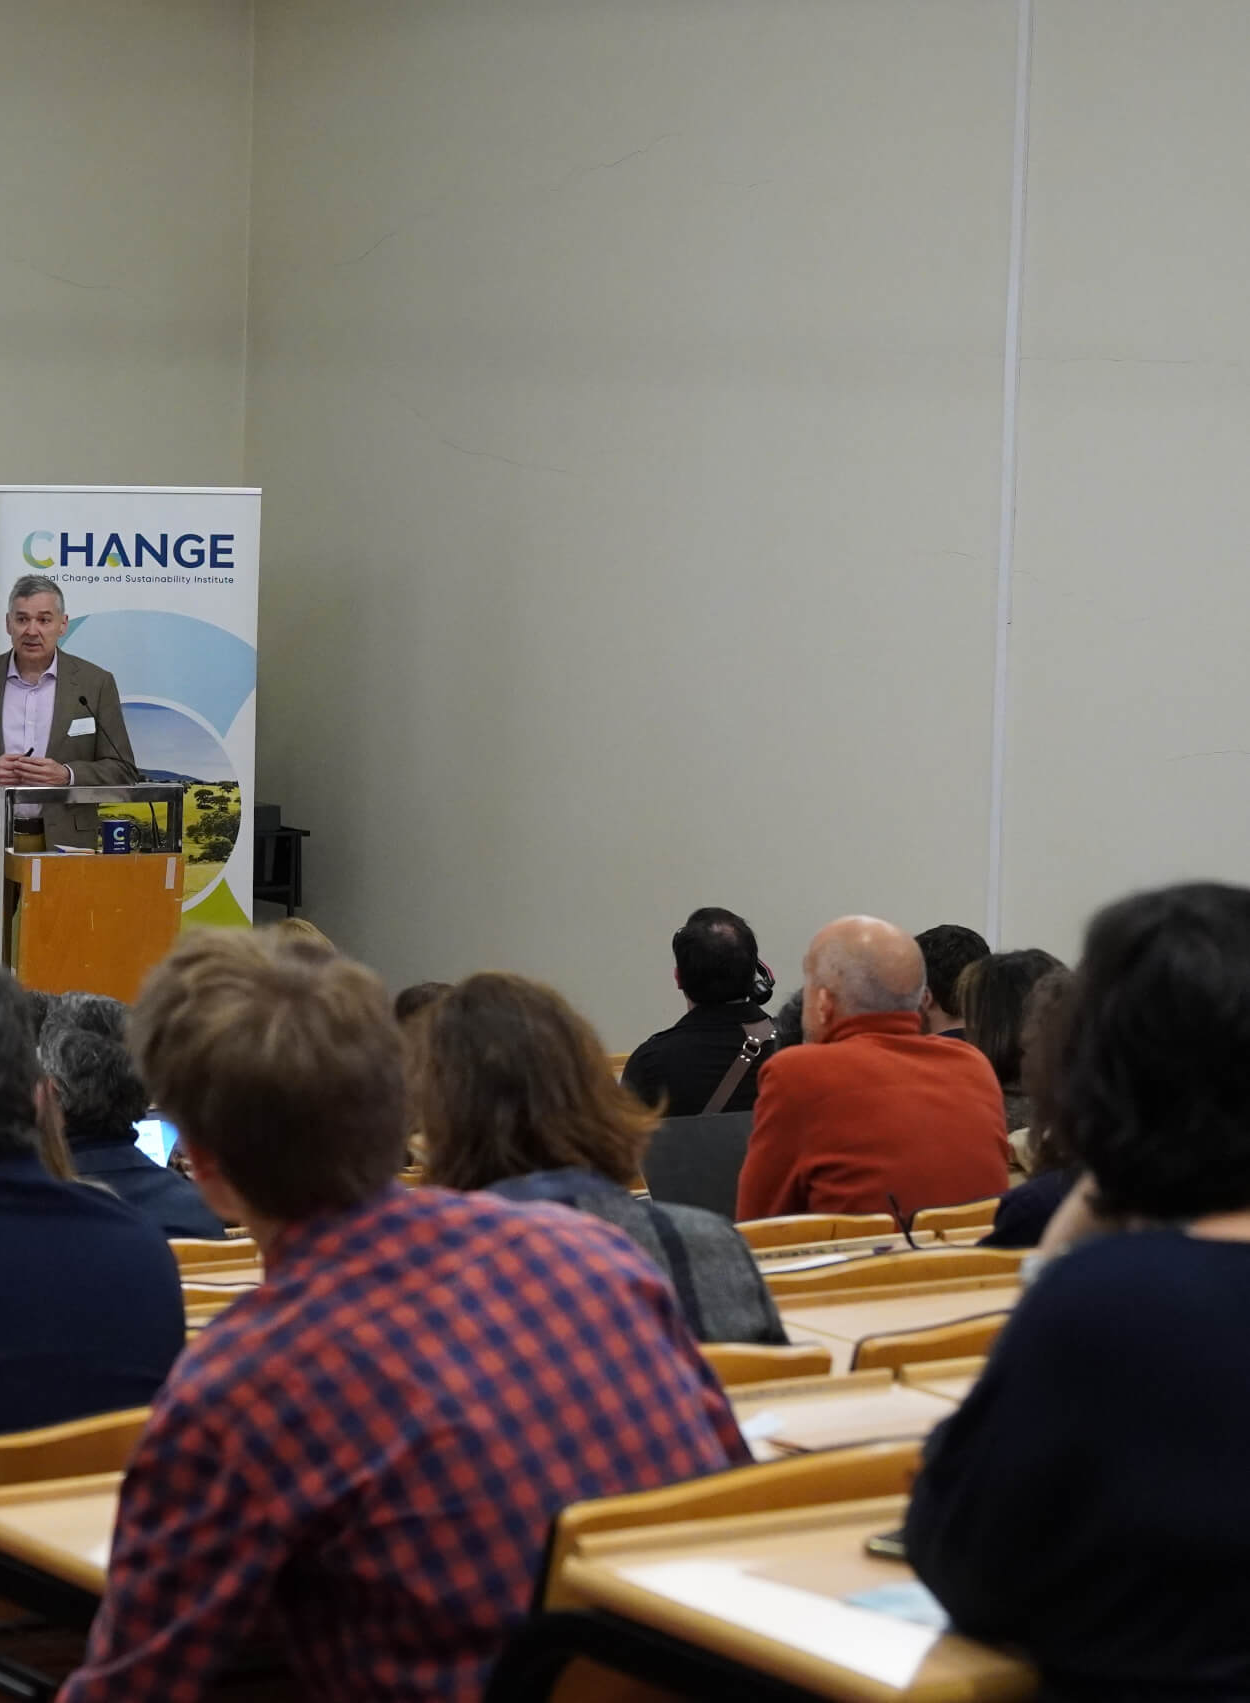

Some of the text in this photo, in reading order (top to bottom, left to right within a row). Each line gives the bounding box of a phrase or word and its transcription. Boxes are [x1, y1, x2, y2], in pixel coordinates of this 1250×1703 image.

[22, 530, 235, 569] CHANGE
[62, 574, 100, 584] Change
[103, 574, 122, 583] and
[125, 574, 191, 585] Sustainability
[194, 575, 234, 584] Institute
